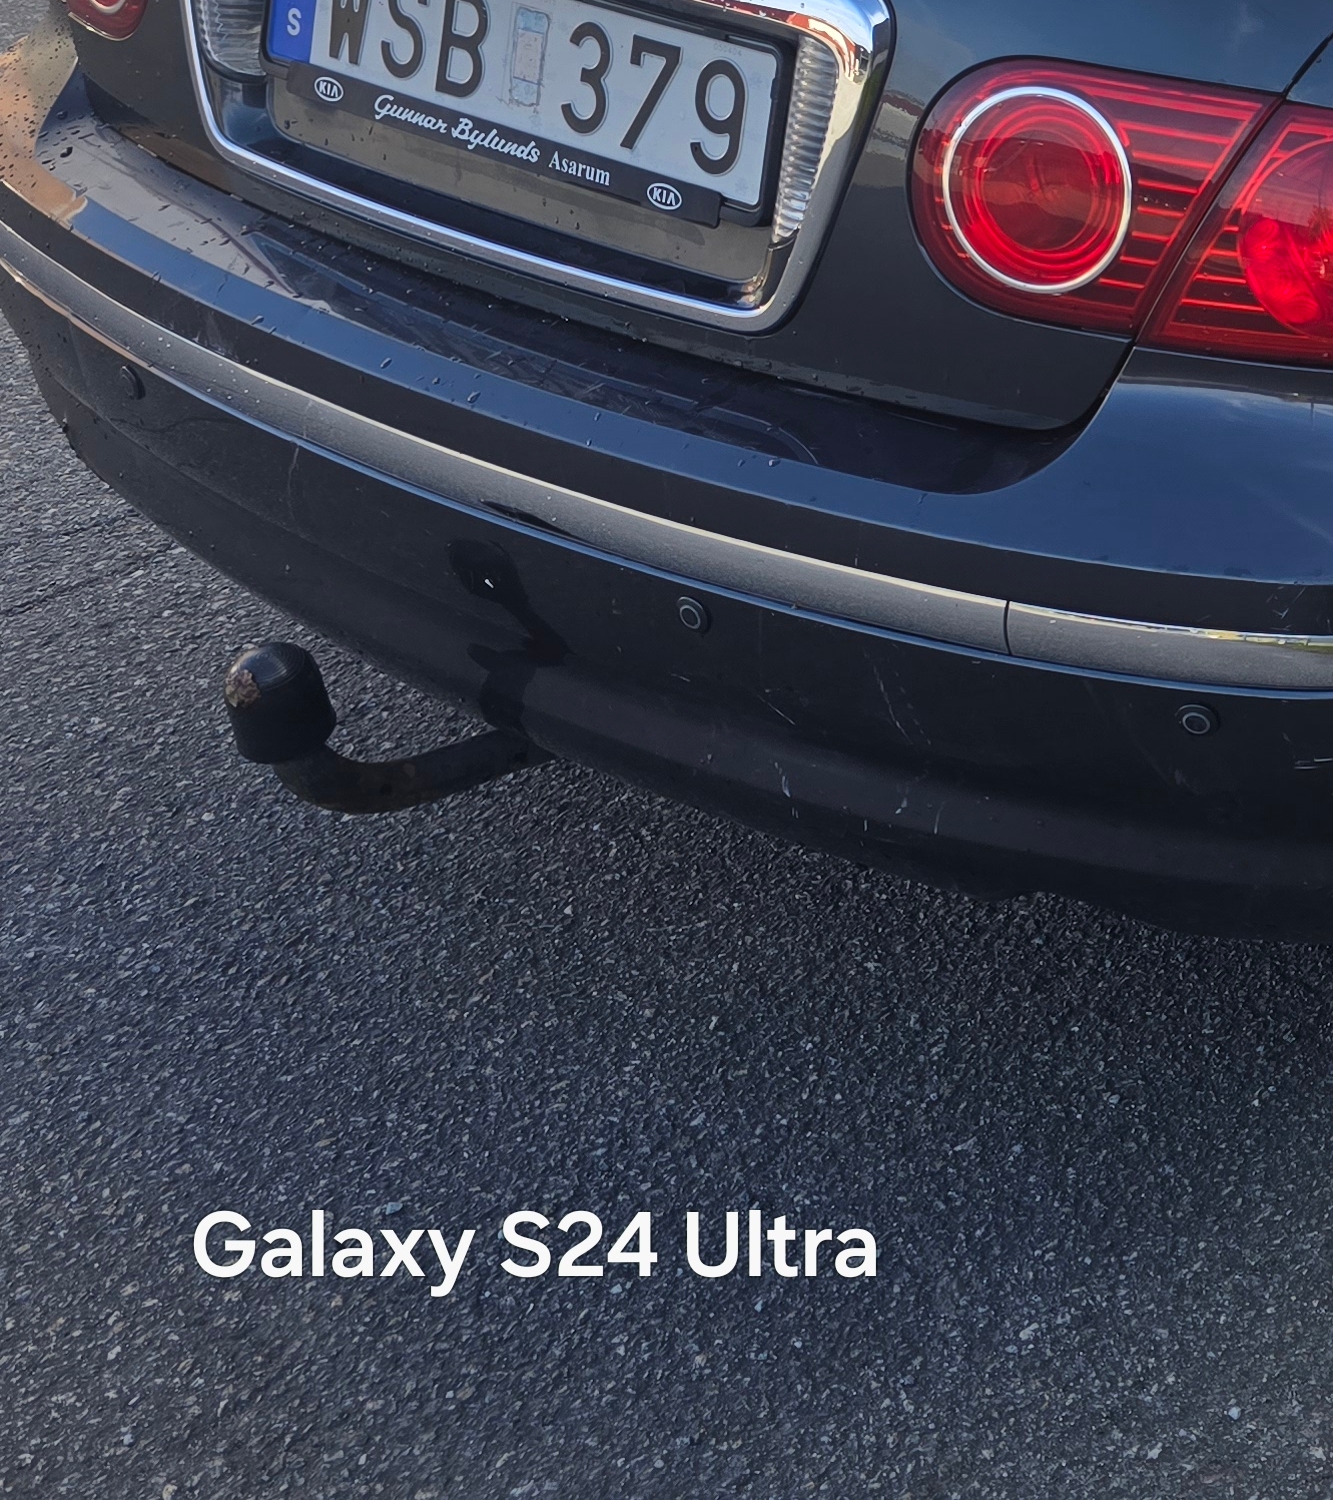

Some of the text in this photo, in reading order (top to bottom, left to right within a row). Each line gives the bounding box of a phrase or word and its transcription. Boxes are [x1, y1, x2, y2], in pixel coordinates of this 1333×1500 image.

[287, 7, 302, 36] S
[317, 80, 342, 99] KIA
[561, 21, 747, 176] 379
[374, 94, 611, 186] Gunnar Bylunds Asarum
[651, 187, 677, 206] KIA
